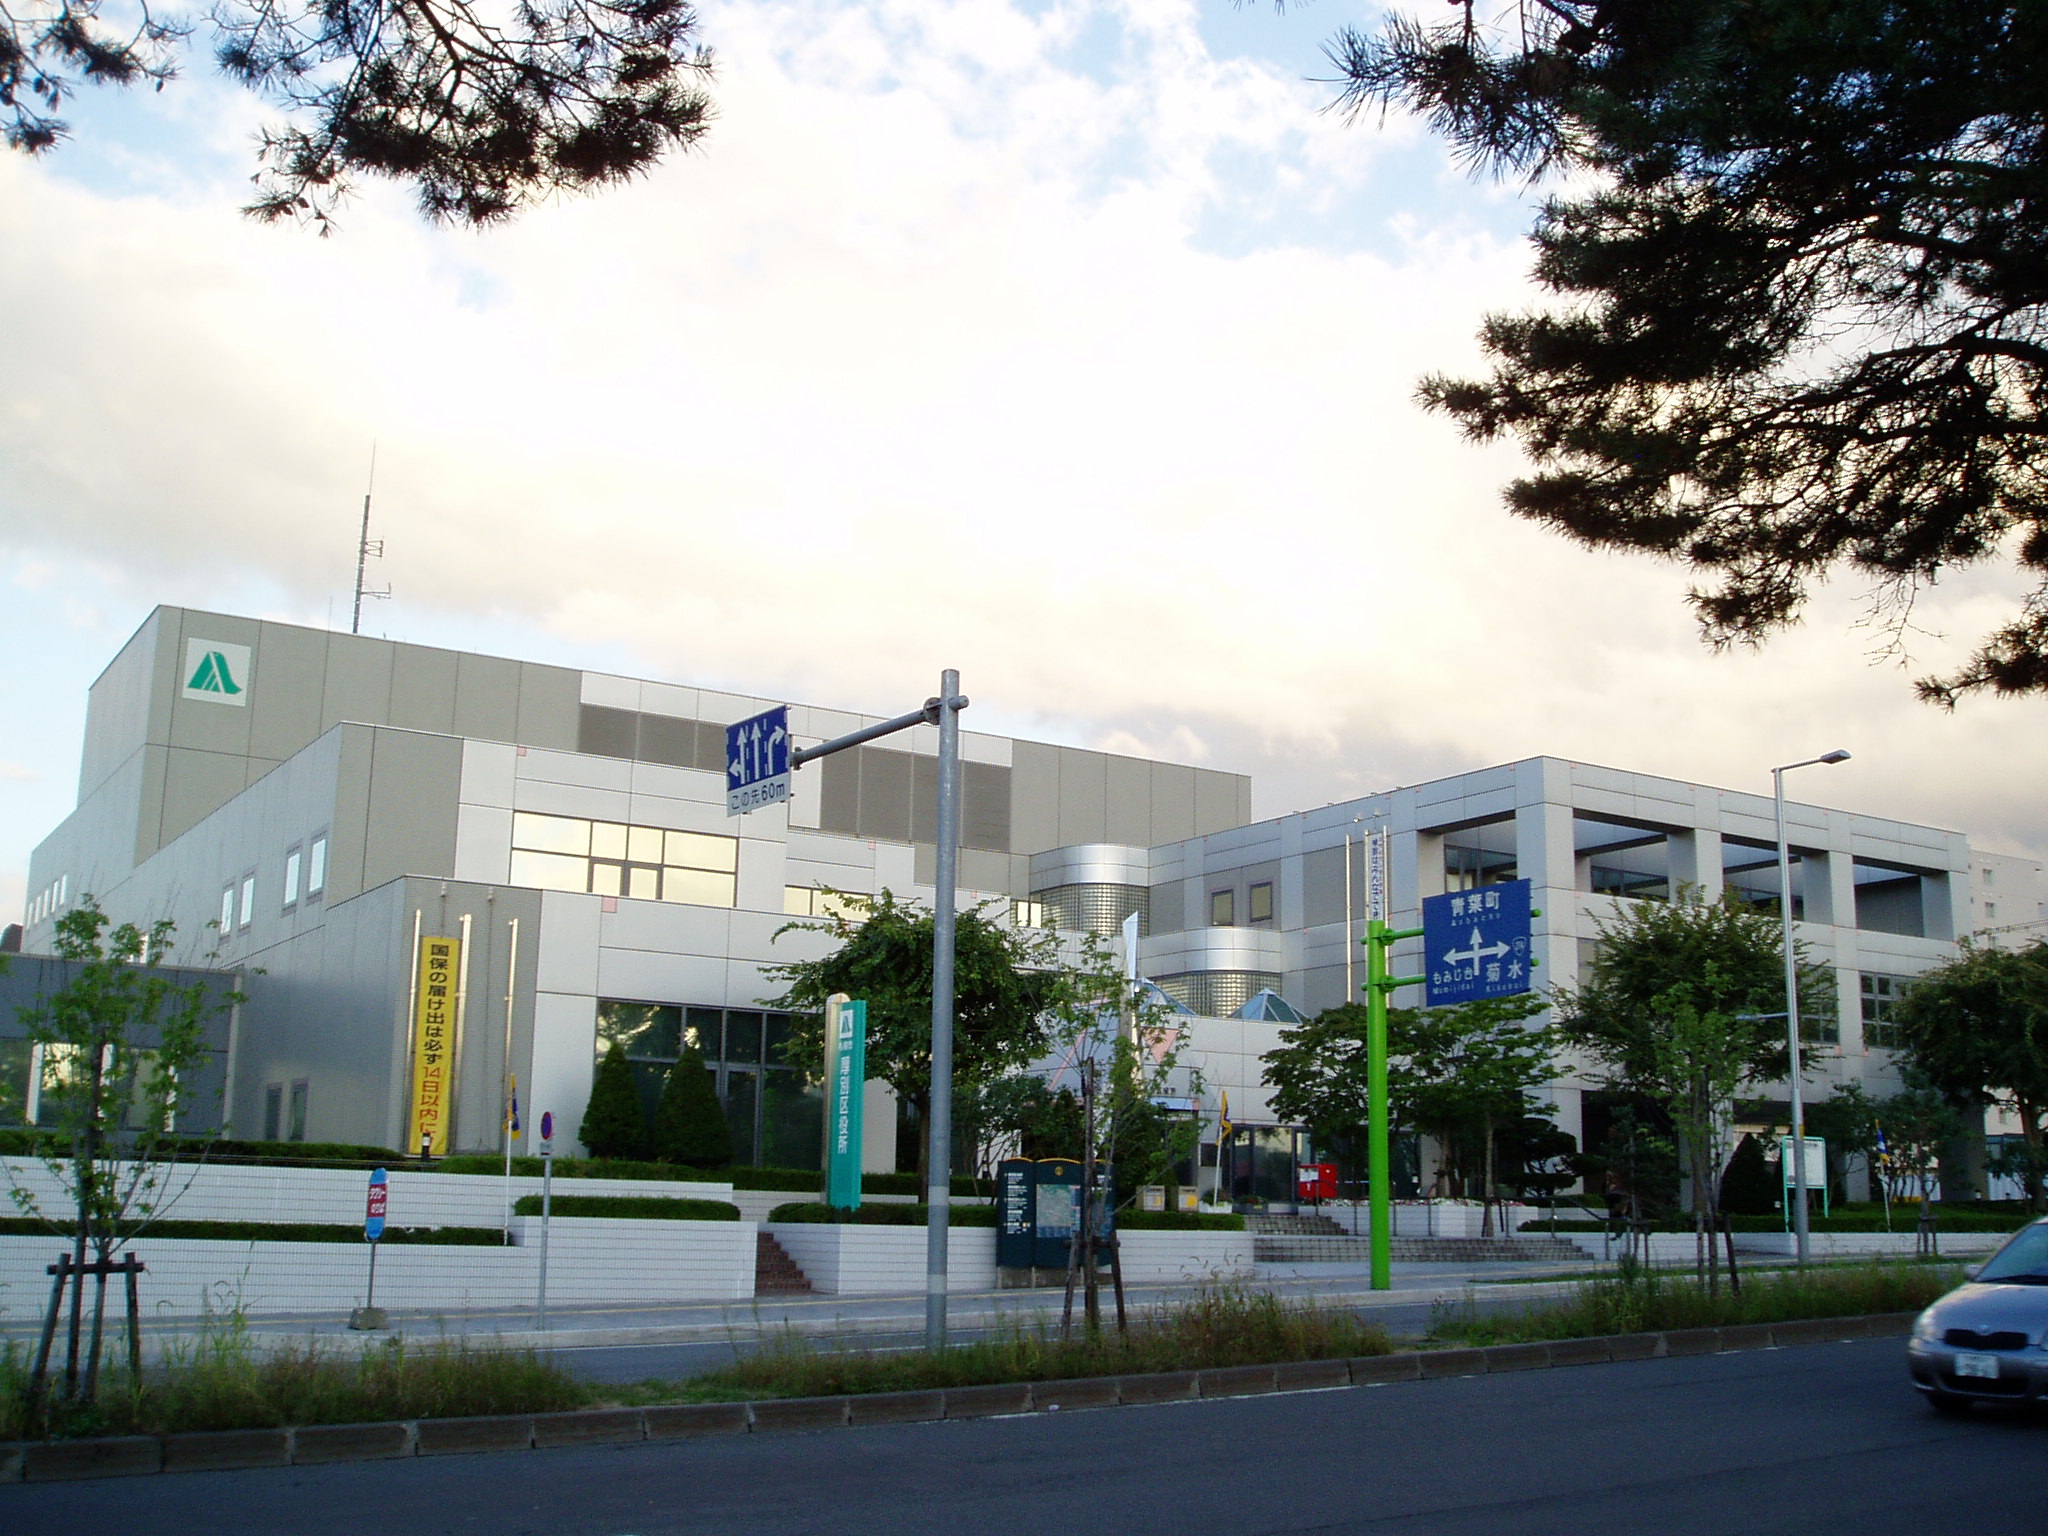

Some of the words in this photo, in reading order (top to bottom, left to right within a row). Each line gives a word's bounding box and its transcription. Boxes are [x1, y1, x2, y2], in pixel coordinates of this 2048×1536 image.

[732, 782, 785, 810] この先60m
[1451, 891, 1500, 917] 青葉町
[1433, 967, 1473, 985] もみじ台
[1485, 960, 1523, 982] 菊水
